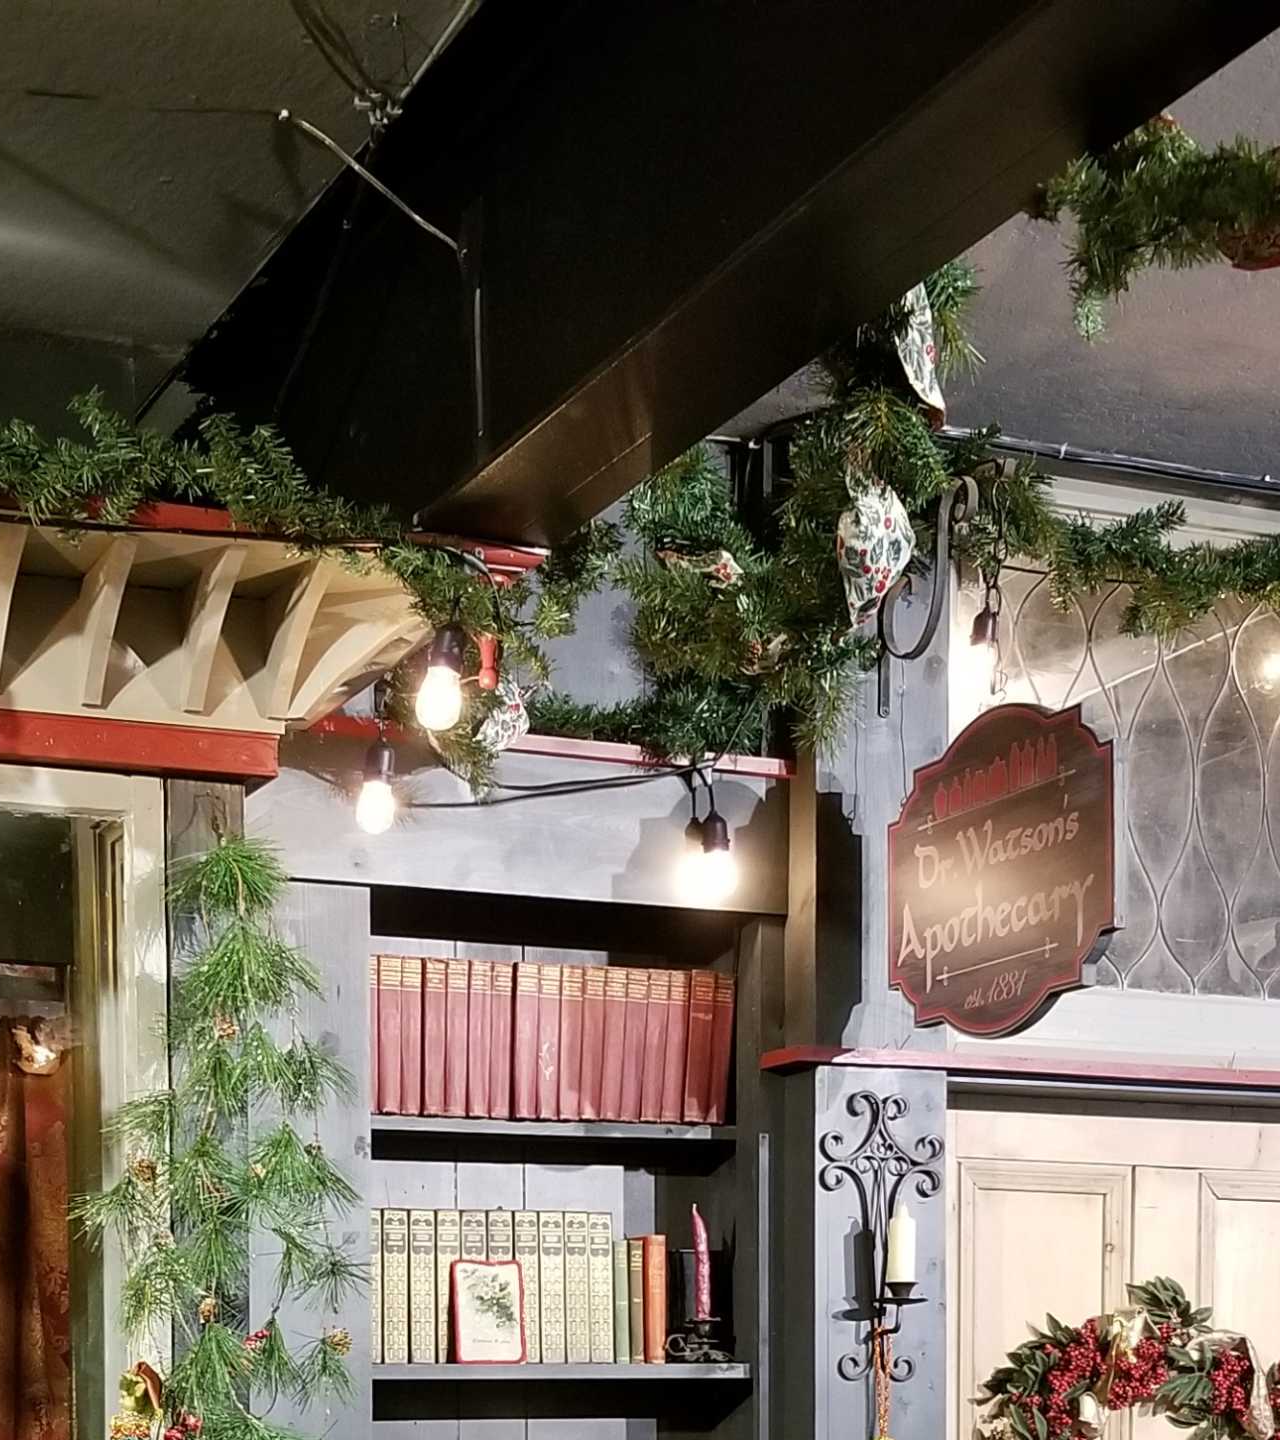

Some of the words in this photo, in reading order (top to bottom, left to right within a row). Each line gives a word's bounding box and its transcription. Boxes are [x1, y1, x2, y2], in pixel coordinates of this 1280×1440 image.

[914, 843, 959, 889] Dr.
[956, 793, 1080, 876] Watson's
[896, 873, 1096, 994] Apothecary
